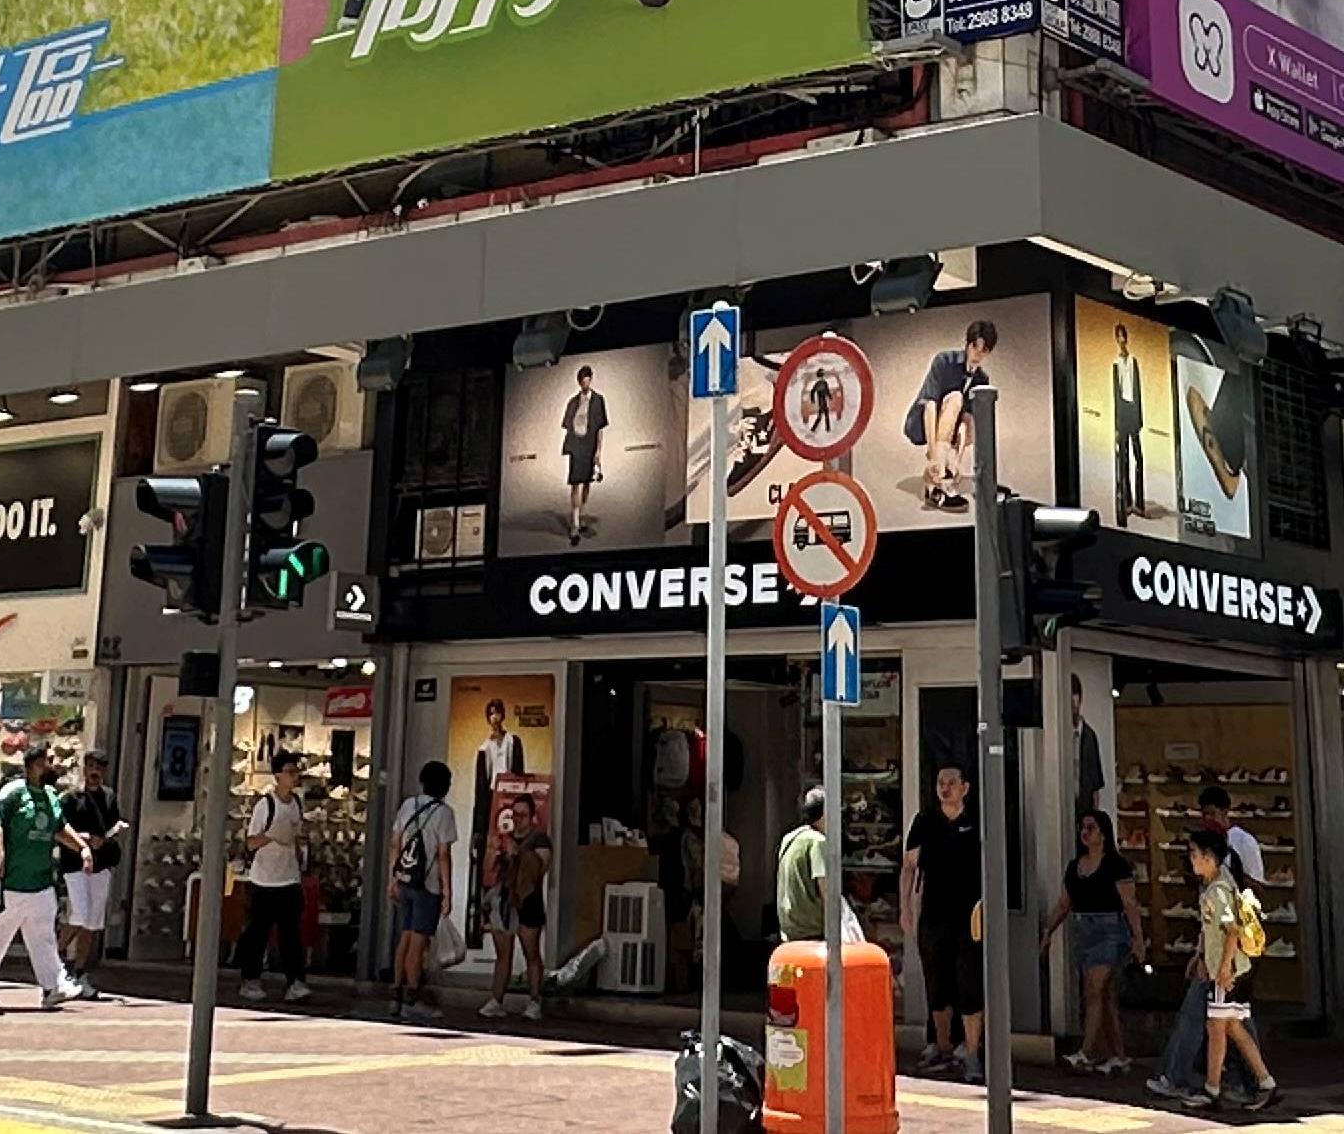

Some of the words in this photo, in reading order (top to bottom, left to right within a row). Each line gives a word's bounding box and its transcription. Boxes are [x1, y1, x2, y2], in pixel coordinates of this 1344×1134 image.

[29, 497, 56, 538] IT.
[529, 563, 780, 615] CONVERSE
[1132, 556, 1294, 626] CONVERSE
